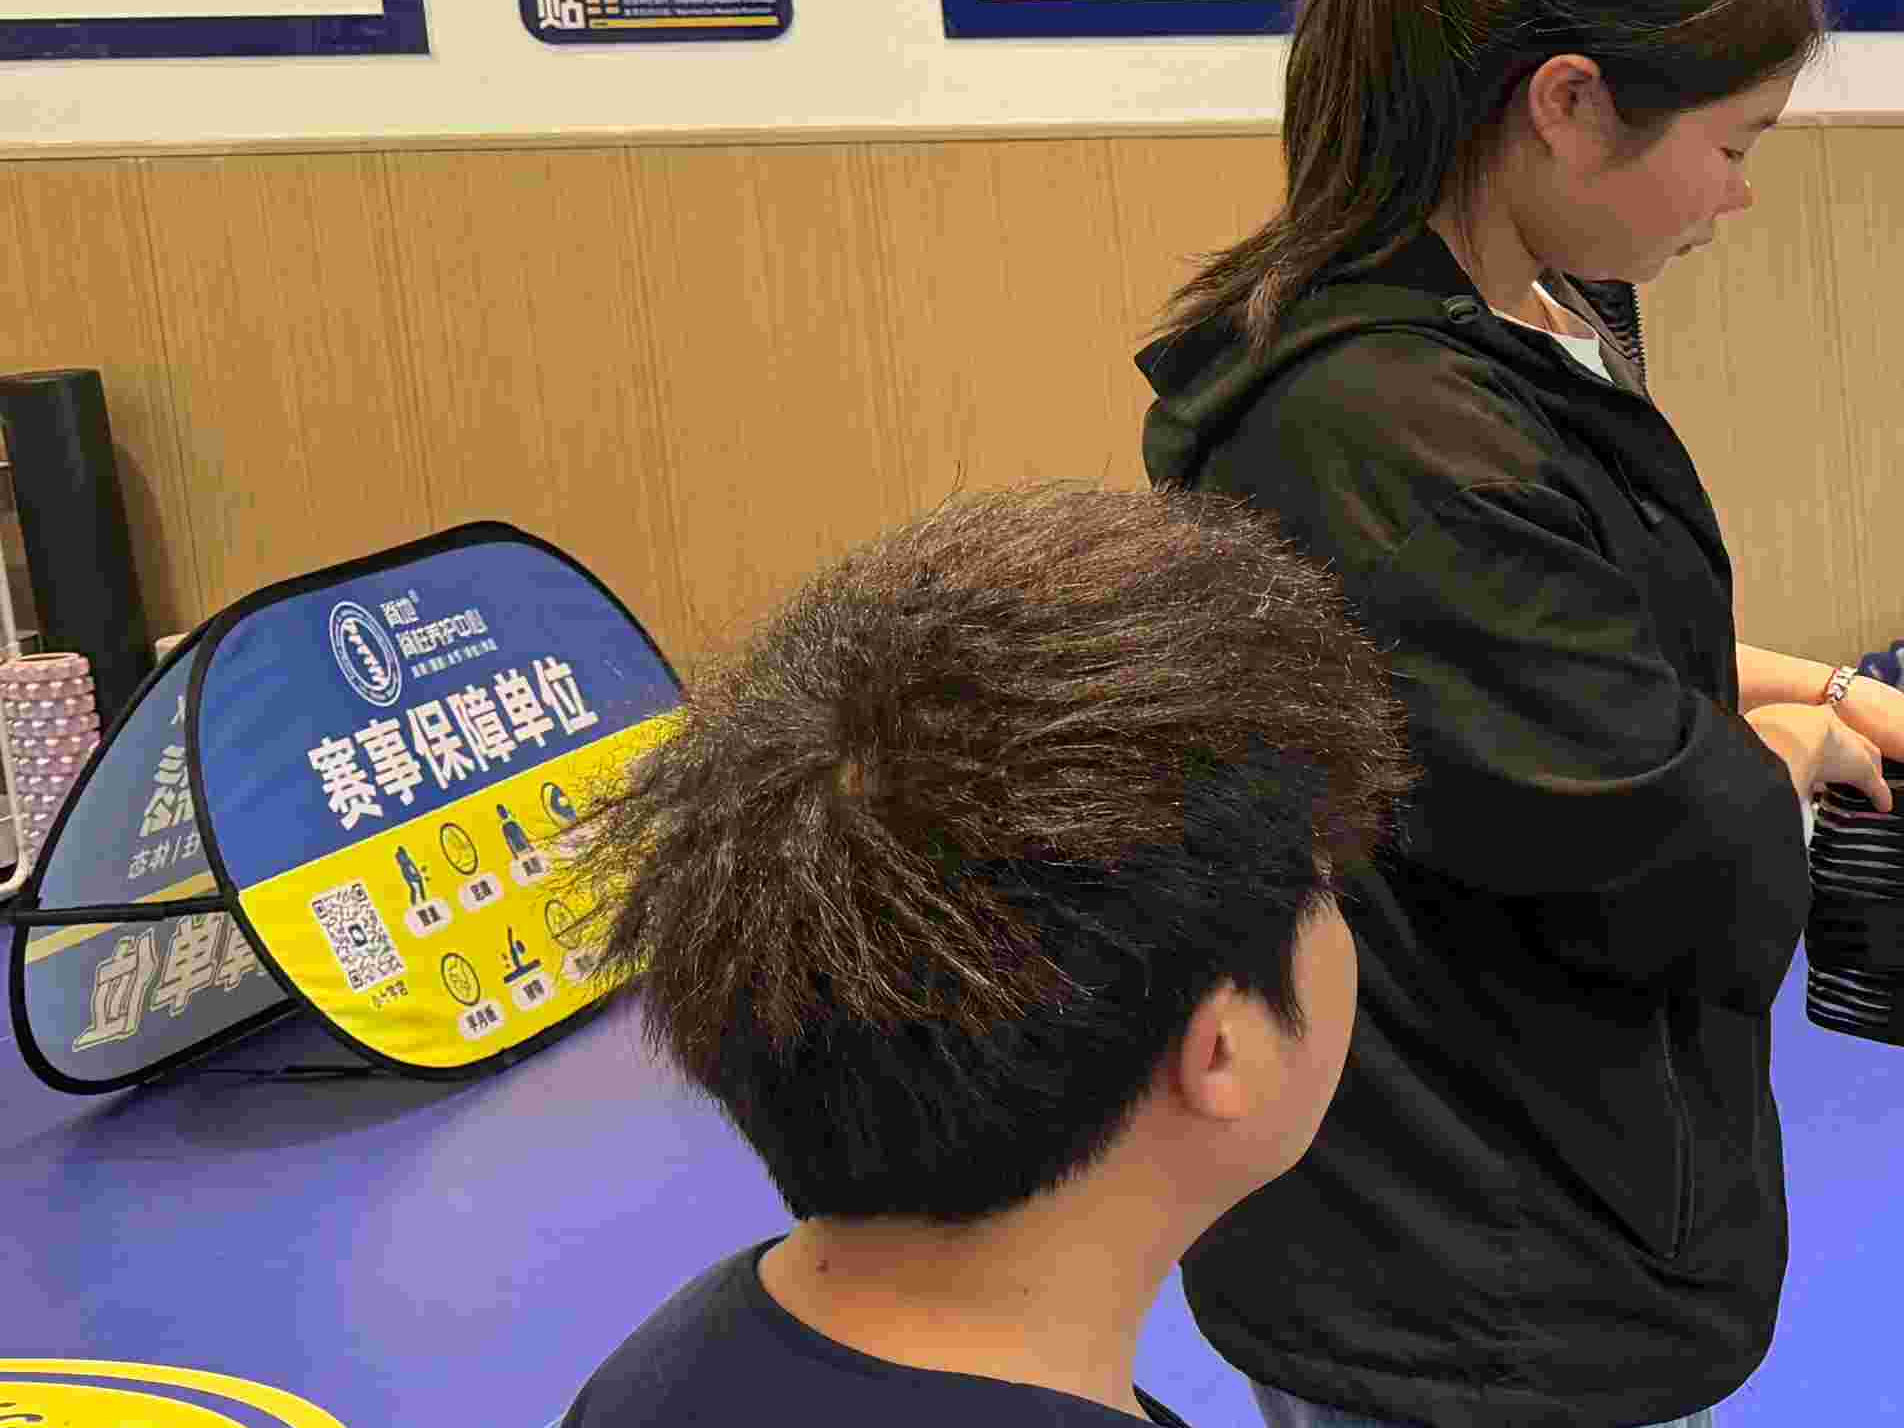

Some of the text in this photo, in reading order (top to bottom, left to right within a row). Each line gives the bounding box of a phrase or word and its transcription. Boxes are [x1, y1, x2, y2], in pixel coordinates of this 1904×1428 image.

[307, 656, 599, 830] 赛事保障单位
